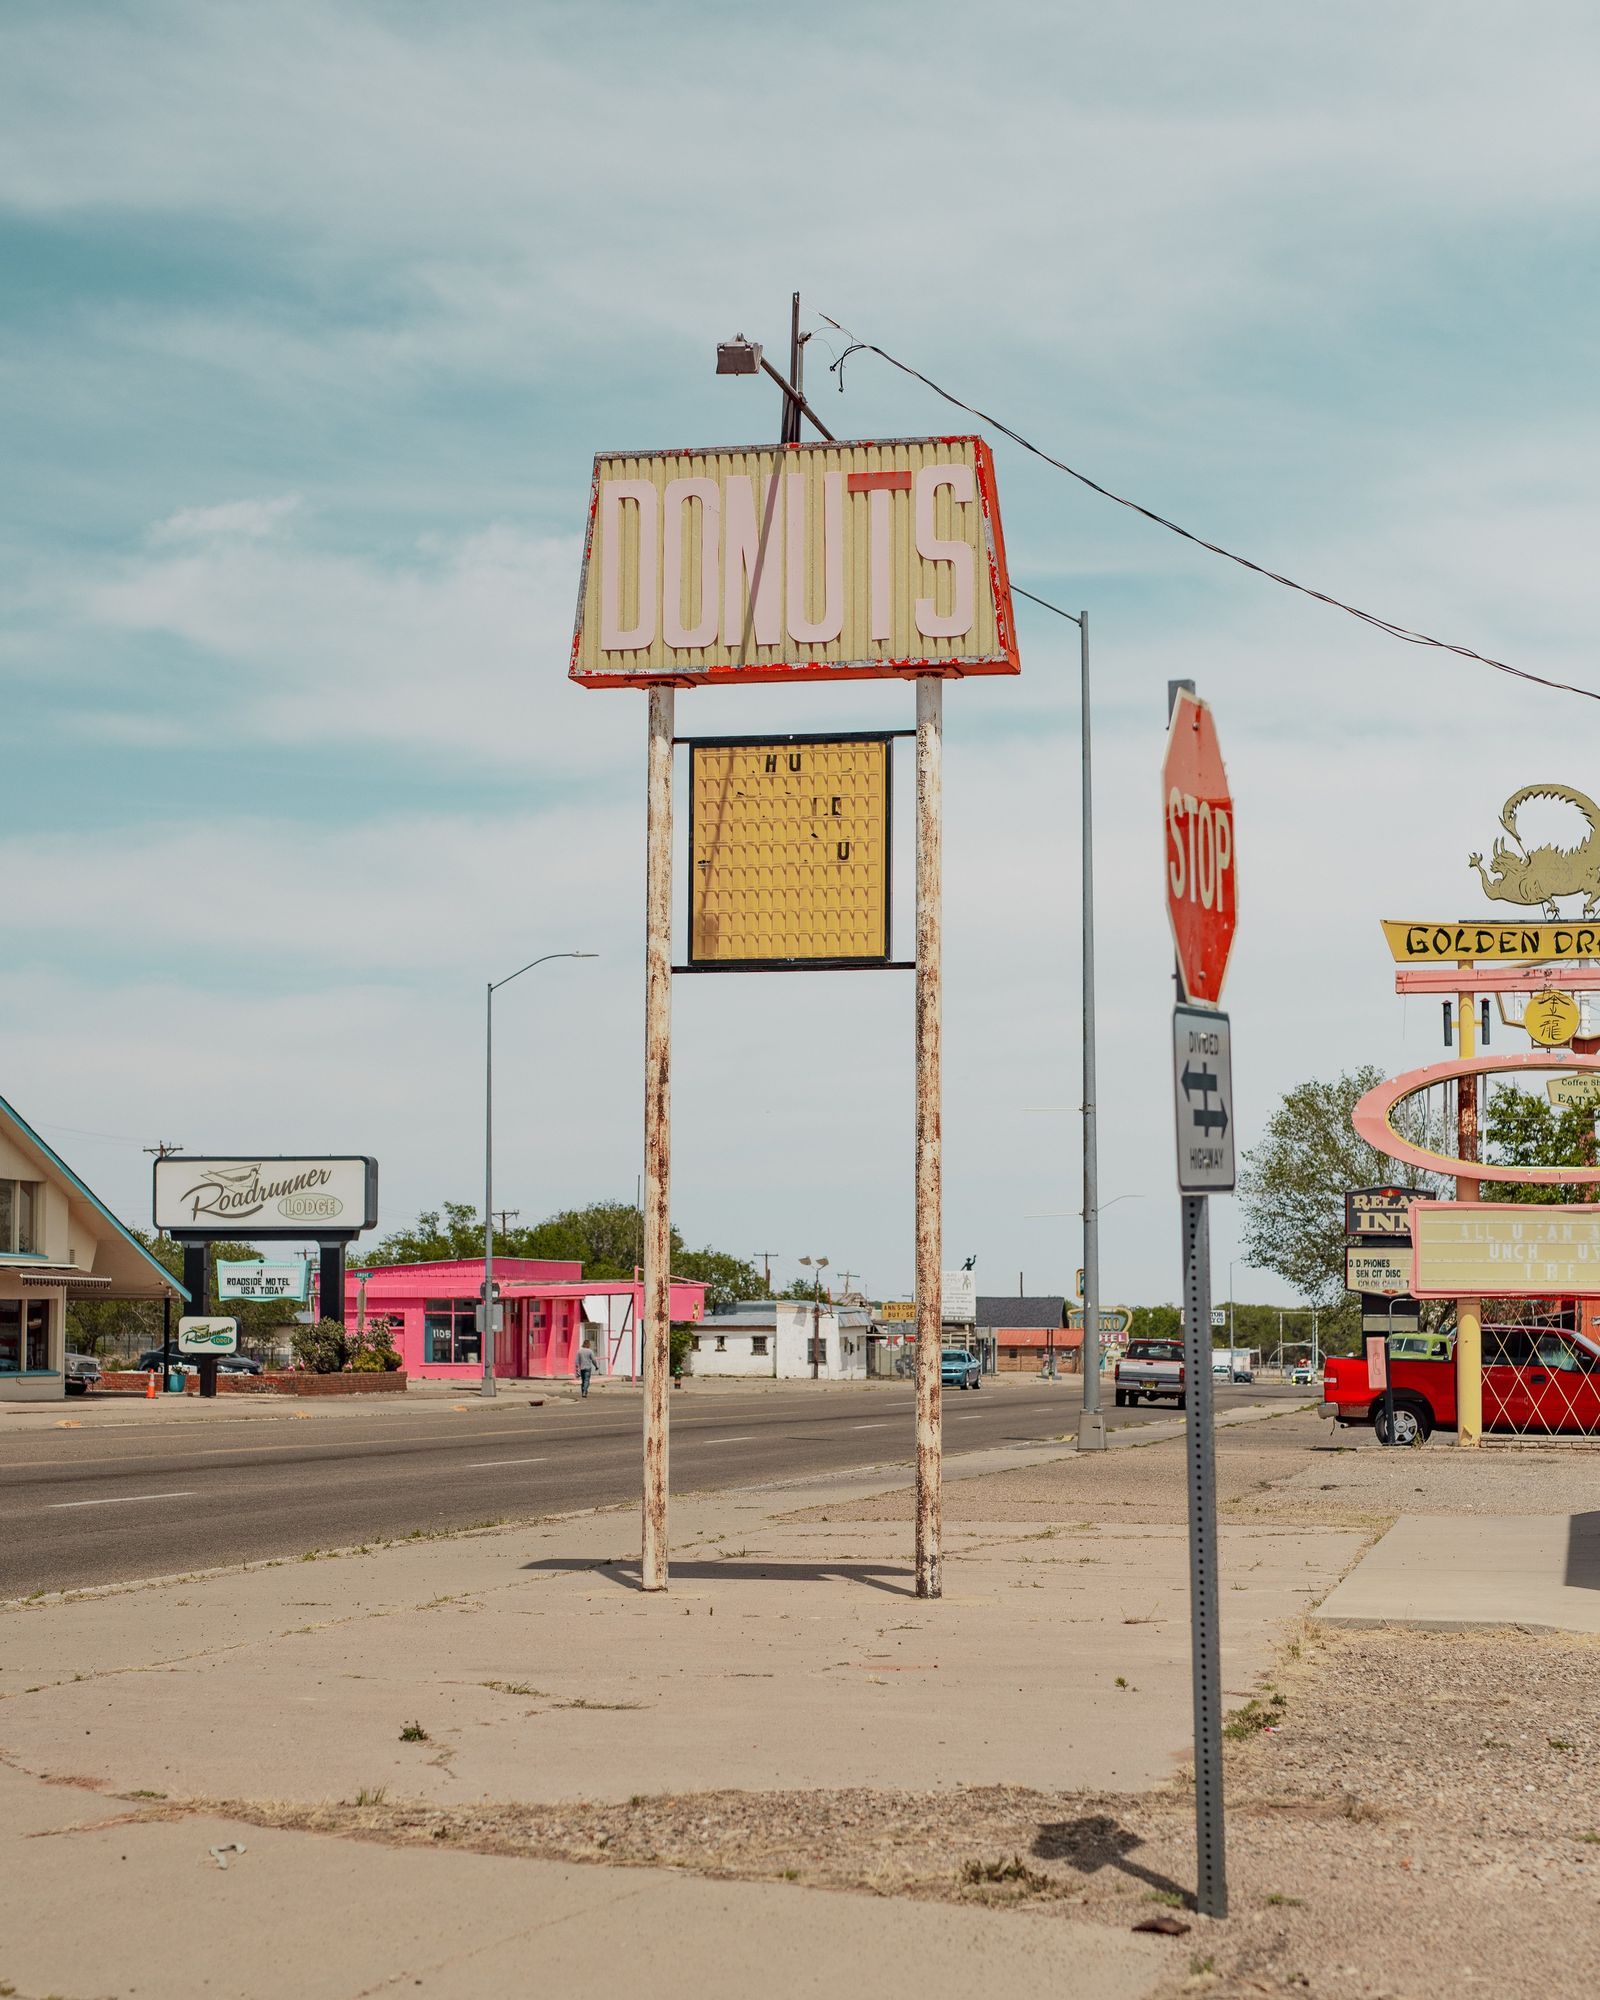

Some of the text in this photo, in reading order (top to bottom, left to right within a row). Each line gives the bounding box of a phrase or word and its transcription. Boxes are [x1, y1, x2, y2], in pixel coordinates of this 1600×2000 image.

[602, 464, 974, 650] DONUTS
[1169, 786, 1231, 912] STOP
[1406, 927, 1600, 955] GOLDEN DR
[1188, 1031, 1219, 1055] DIVIDED
[1190, 1148, 1224, 1170] HIGHWAY
[180, 1167, 332, 1222] Roadrunner
[285, 1198, 336, 1216] LODGE
[1356, 1269, 1401, 1278] SEN CIT DISC
[1363, 1259, 1391, 1268] PHONES
[226, 1277, 262, 1286] ROADSIDE
[240, 1286, 285, 1295] USA TODAY
[432, 1328, 452, 1339] 1105
